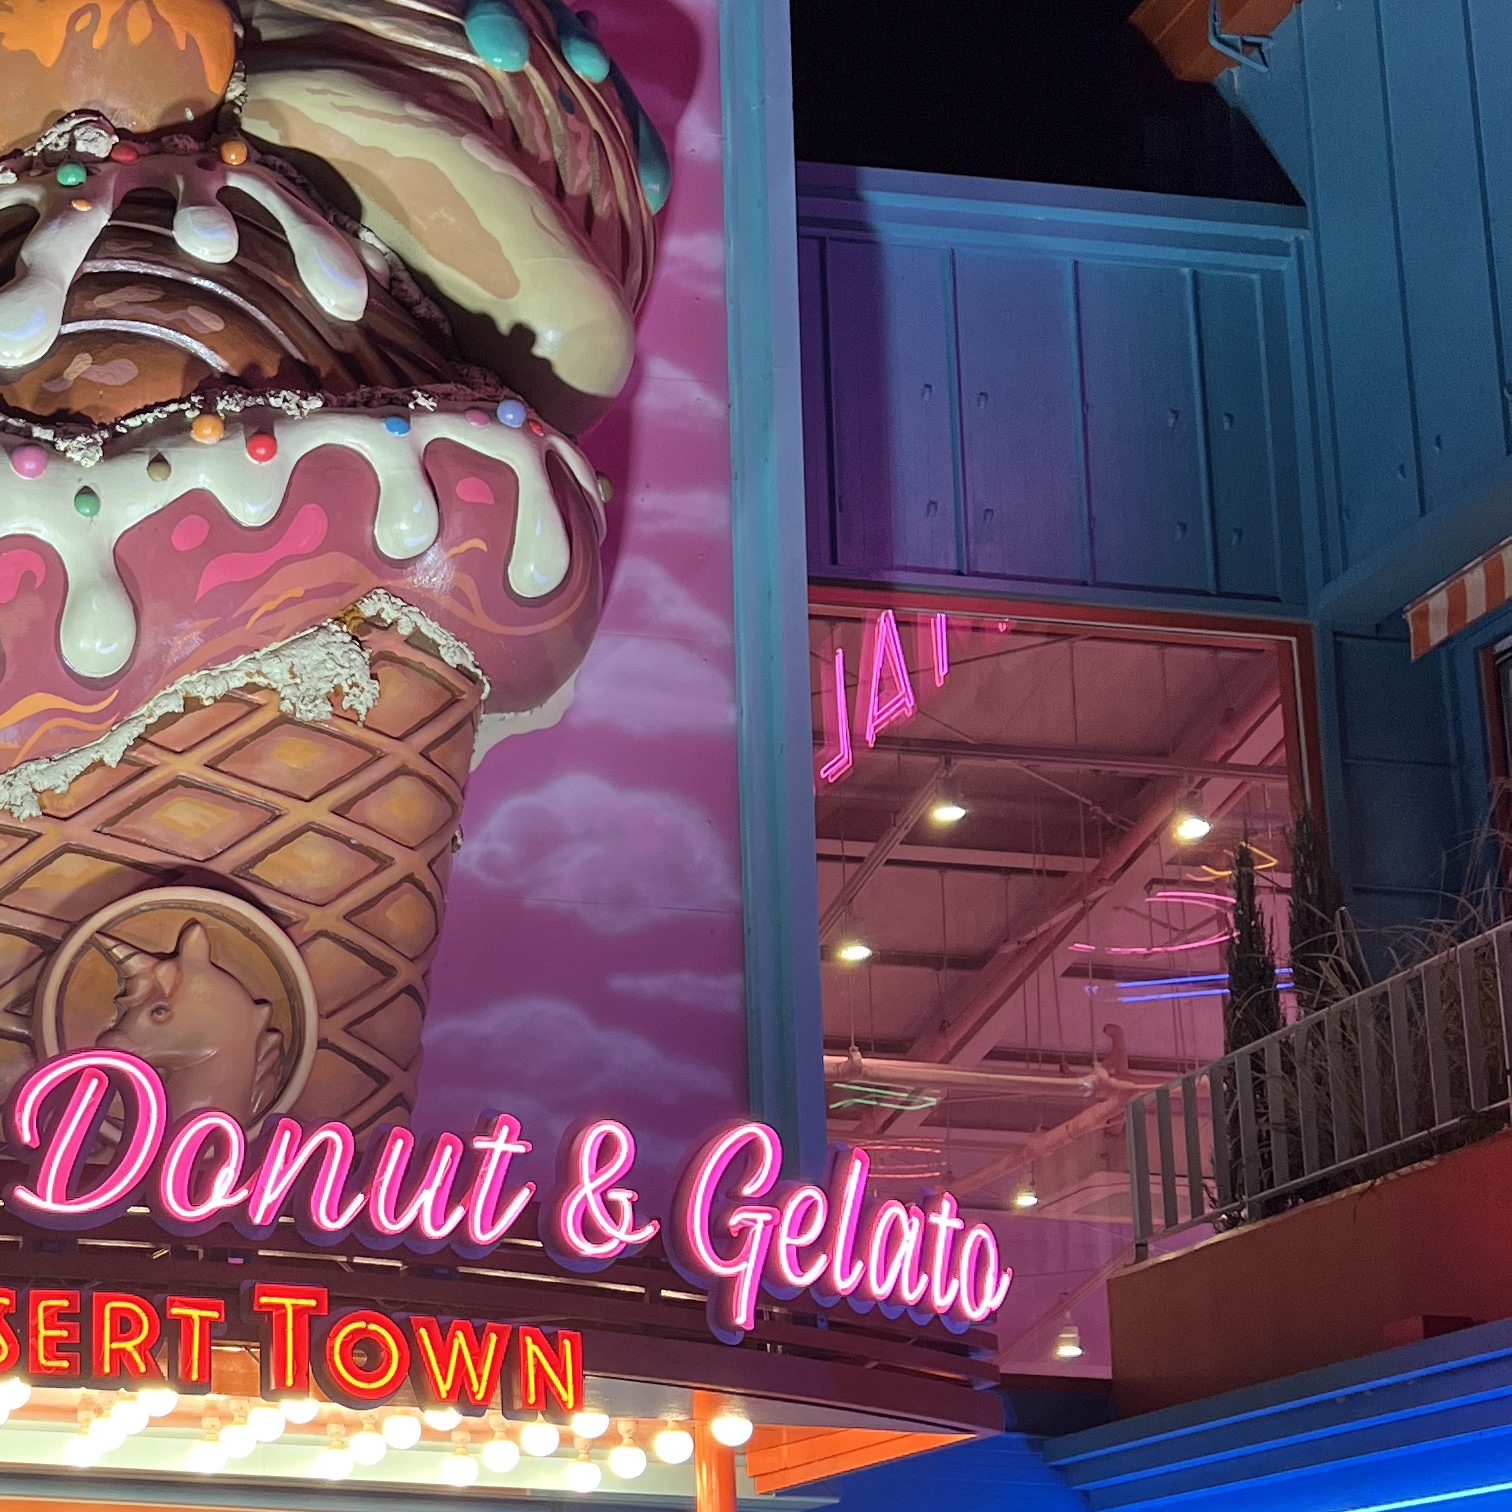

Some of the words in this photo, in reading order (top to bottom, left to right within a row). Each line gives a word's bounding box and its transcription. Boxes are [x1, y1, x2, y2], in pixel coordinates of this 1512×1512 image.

[11, 1046, 538, 1248] Donut
[560, 1118, 660, 1259] &
[688, 1120, 1016, 1332] Gelato
[253, 1283, 584, 1414] TOWN
